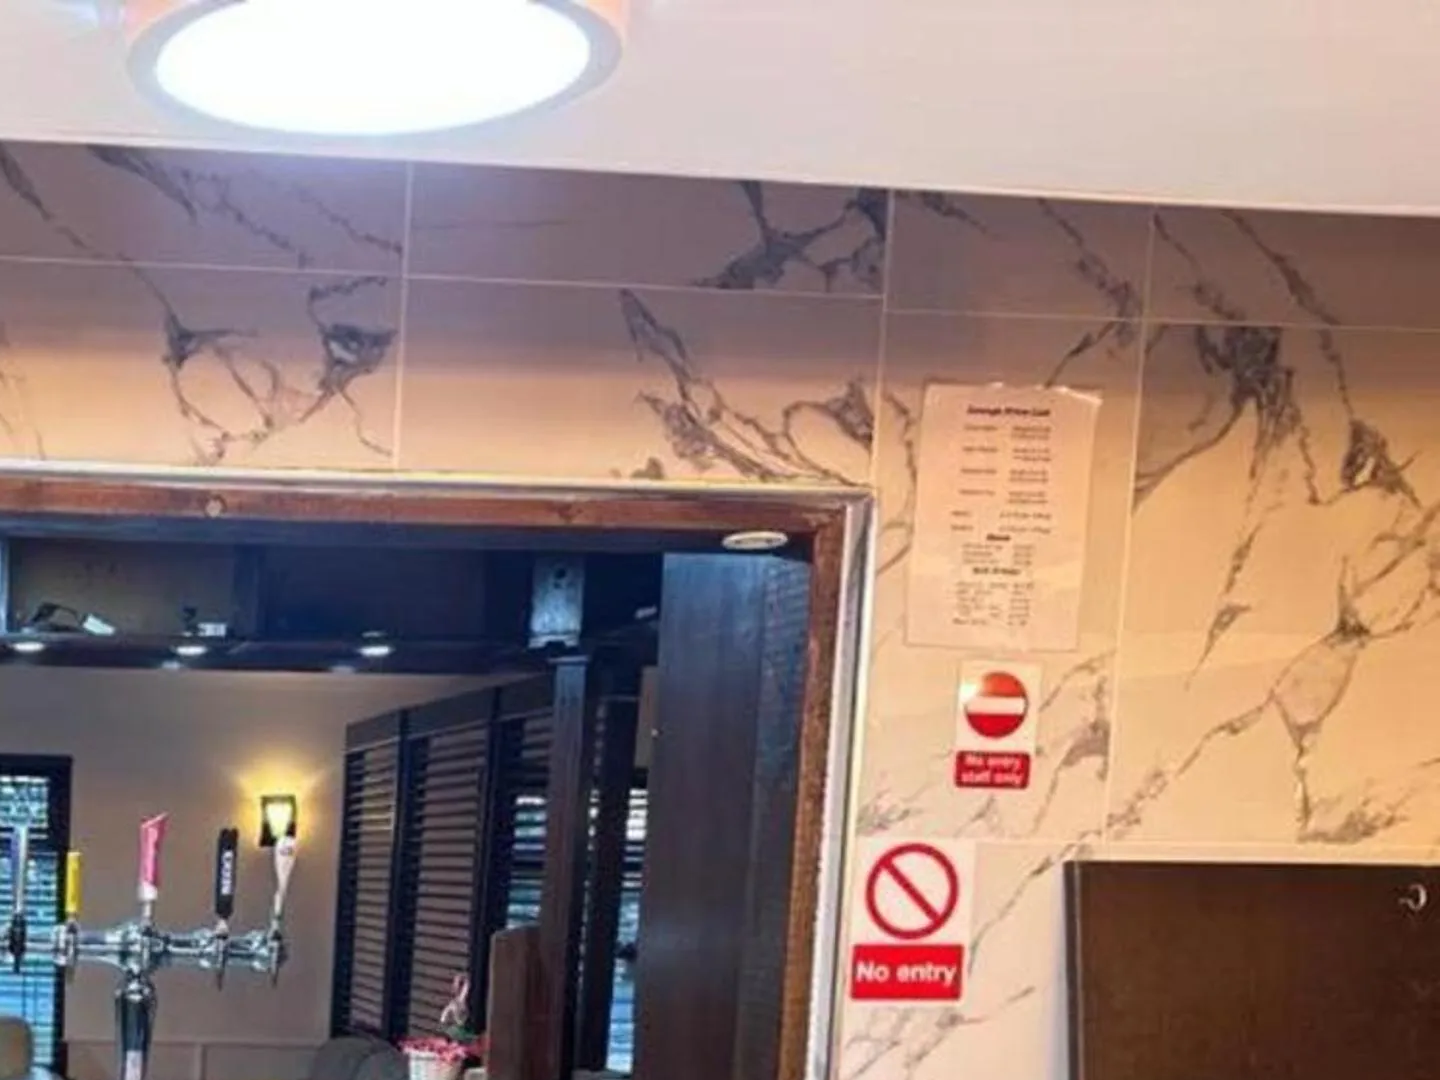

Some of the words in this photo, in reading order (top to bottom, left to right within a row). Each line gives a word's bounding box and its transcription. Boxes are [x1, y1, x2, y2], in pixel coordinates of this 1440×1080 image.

[964, 753, 984, 767] No
[987, 756, 1023, 773] entry
[994, 771, 1024, 787] only
[856, 960, 890, 983] No
[896, 960, 957, 989] entry
